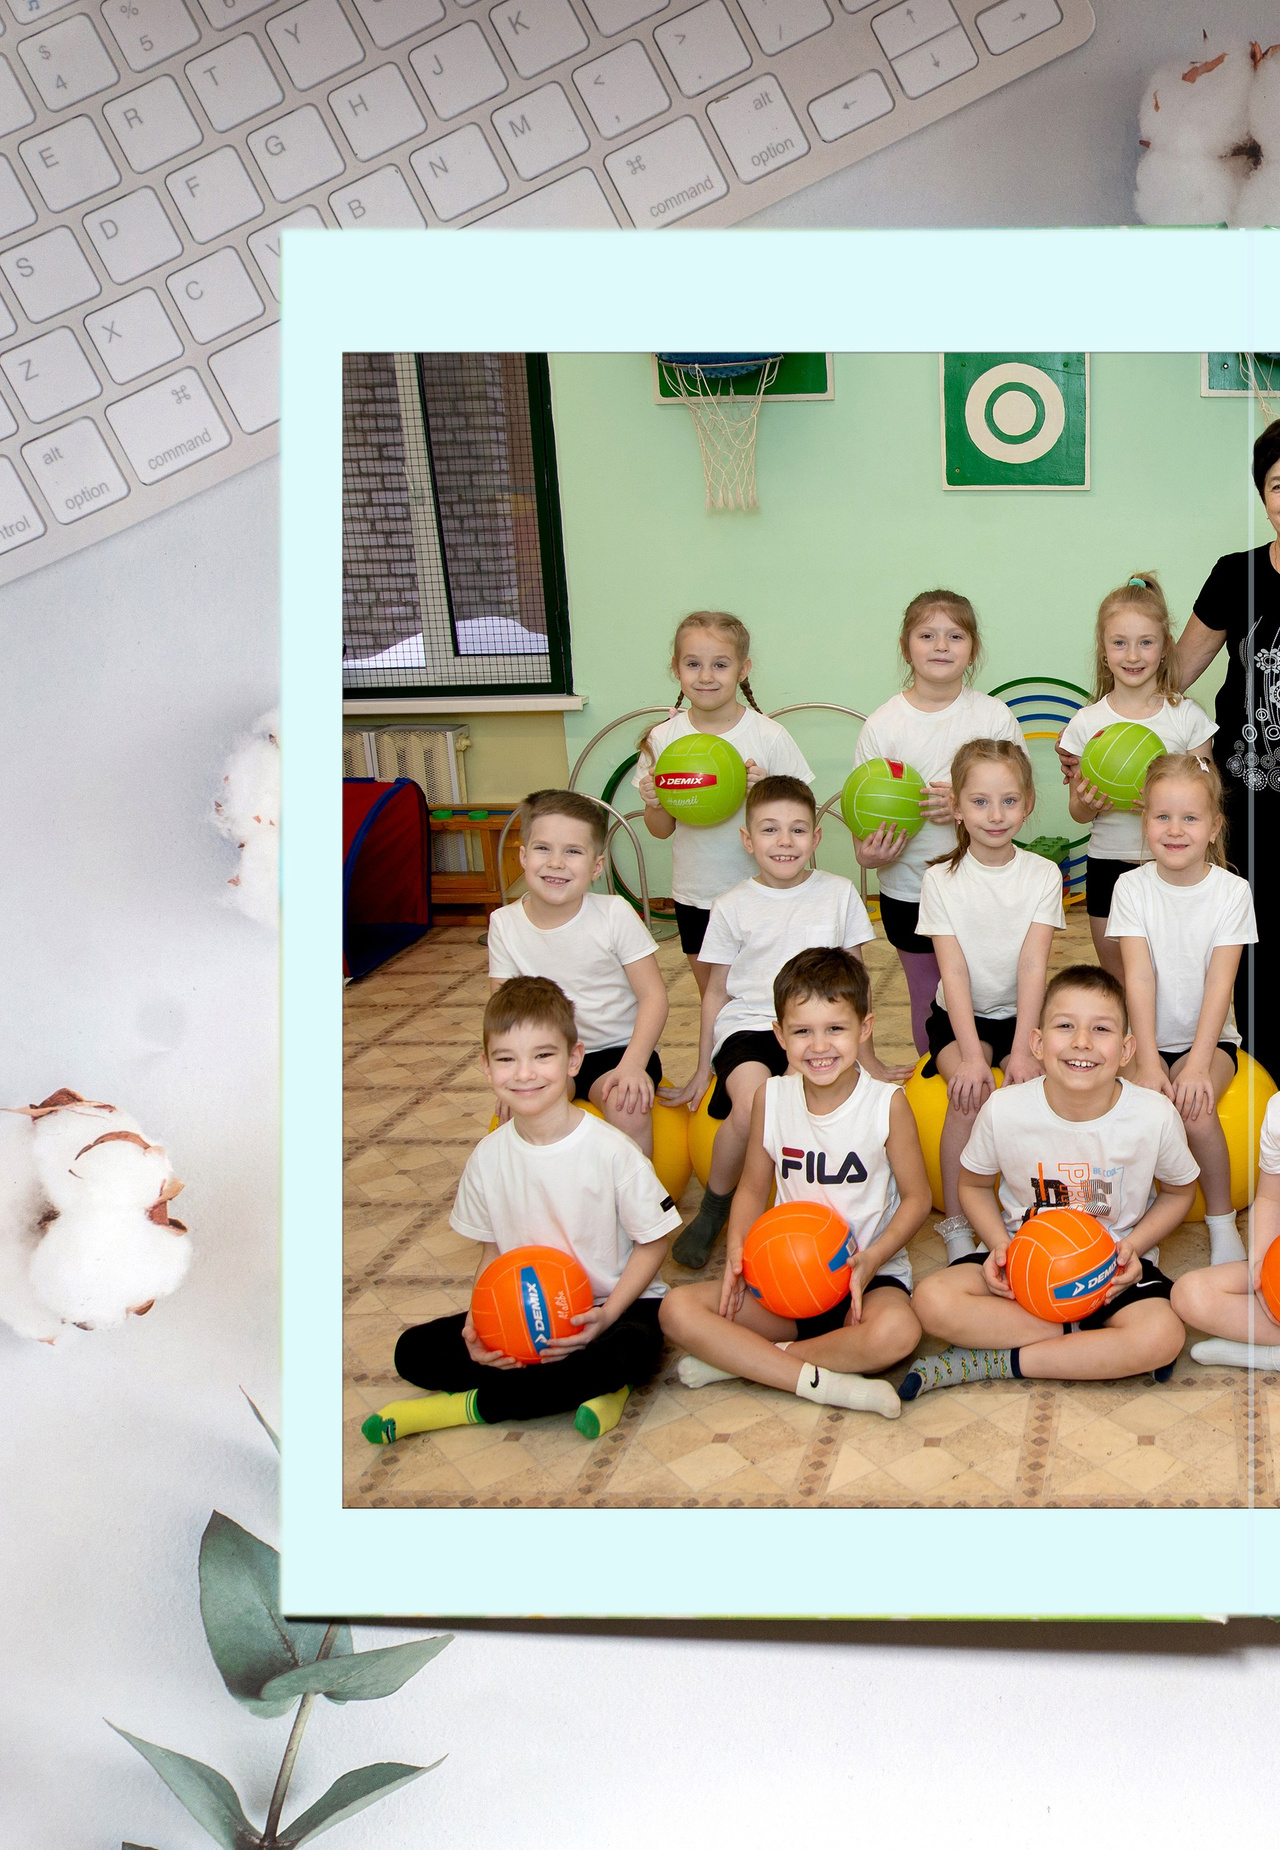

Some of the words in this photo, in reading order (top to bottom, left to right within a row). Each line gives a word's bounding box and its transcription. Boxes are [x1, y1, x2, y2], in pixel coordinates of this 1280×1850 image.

[284, 23, 300, 44] Y
[508, 10, 530, 35] K
[139, 35, 153, 51] 5
[203, 65, 219, 87] T
[432, 54, 444, 76] J
[55, 74, 68, 90] 4
[348, 94, 369, 117] H
[752, 91, 773, 110] alt
[123, 107, 143, 129] R
[508, 114, 532, 138] M
[265, 135, 286, 156] G
[751, 137, 795, 168] option
[38, 146, 59, 168] E
[429, 156, 449, 178] N
[185, 176, 200, 198] F
[649, 175, 714, 218] command
[348, 199, 366, 219] B
[98, 219, 119, 240] D
[16, 257, 35, 278] S
[185, 280, 204, 300] C
[101, 321, 122, 343] X
[18, 359, 39, 381] Z
[42, 446, 64, 465] alt
[147, 427, 212, 470] command
[64, 481, 110, 511] option
[667, 777, 704, 786] DEMIX
[667, 795, 698, 806] Hawaii
[781, 1146, 868, 1185] FILA
[526, 1282, 545, 1331] DEMIX
